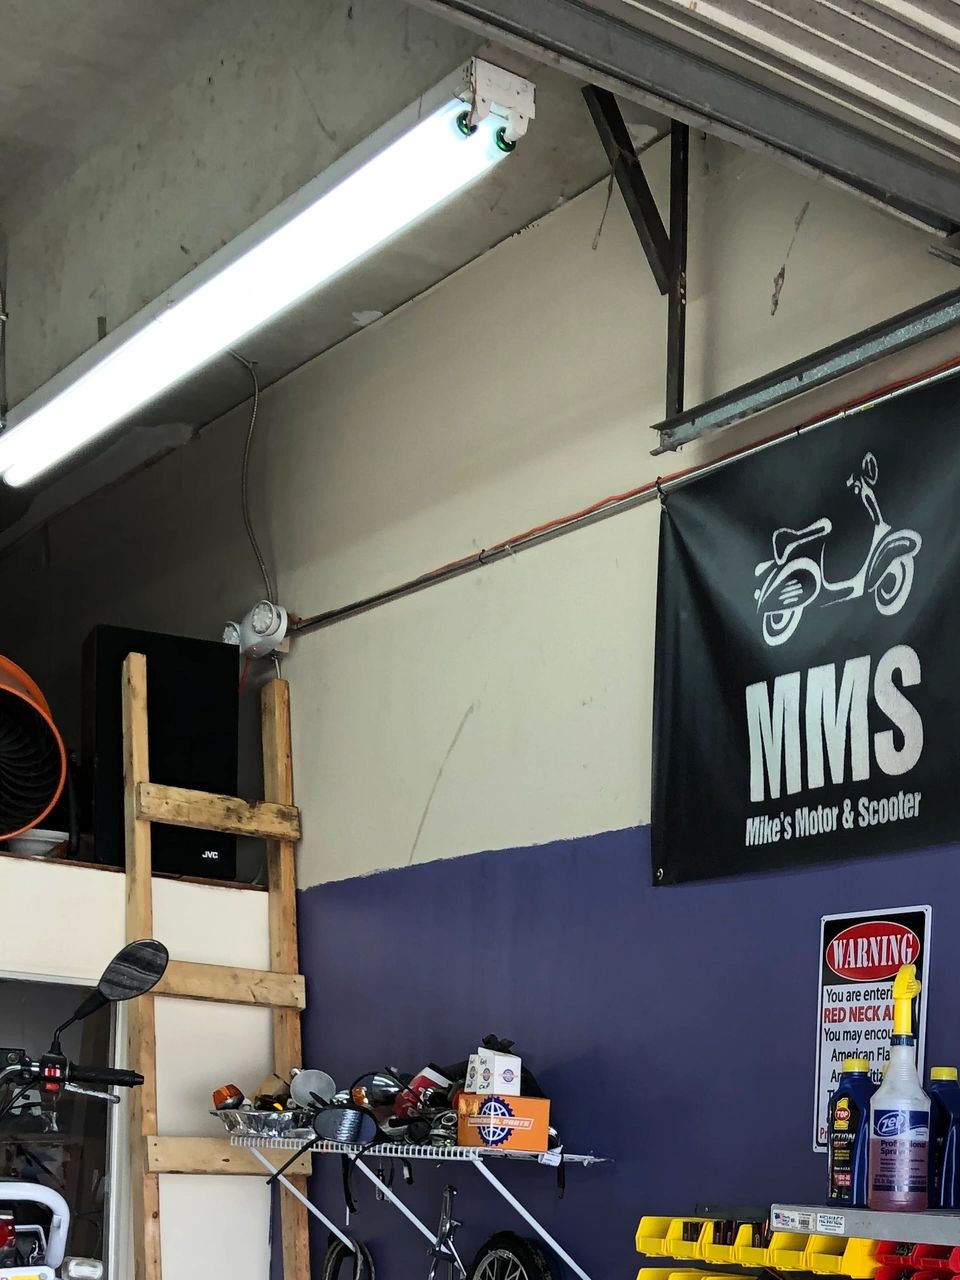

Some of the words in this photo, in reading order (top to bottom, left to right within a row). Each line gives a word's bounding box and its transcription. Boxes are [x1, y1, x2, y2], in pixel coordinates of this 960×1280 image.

[746, 645, 924, 802] MMS
[745, 811, 792, 847] Mike's
[795, 805, 839, 838] Motor
[842, 799, 854, 829] &
[858, 791, 922, 827] Scooter
[202, 850, 219, 859] JVC
[832, 933, 913, 969] WARNING
[826, 988, 843, 1003] You
[846, 991, 862, 1002] are
[864, 985, 893, 1001] enteri
[824, 1006, 846, 1023] RED
[849, 1004, 881, 1022] NECK
[824, 1028, 840, 1041] You
[843, 1030, 863, 1044] may
[864, 1029, 893, 1040] encou
[831, 1048, 874, 1062] American
[877, 1046, 890, 1061] Fla
[830, 1069, 842, 1082] Ar
[836, 1110, 849, 1118] TOP
